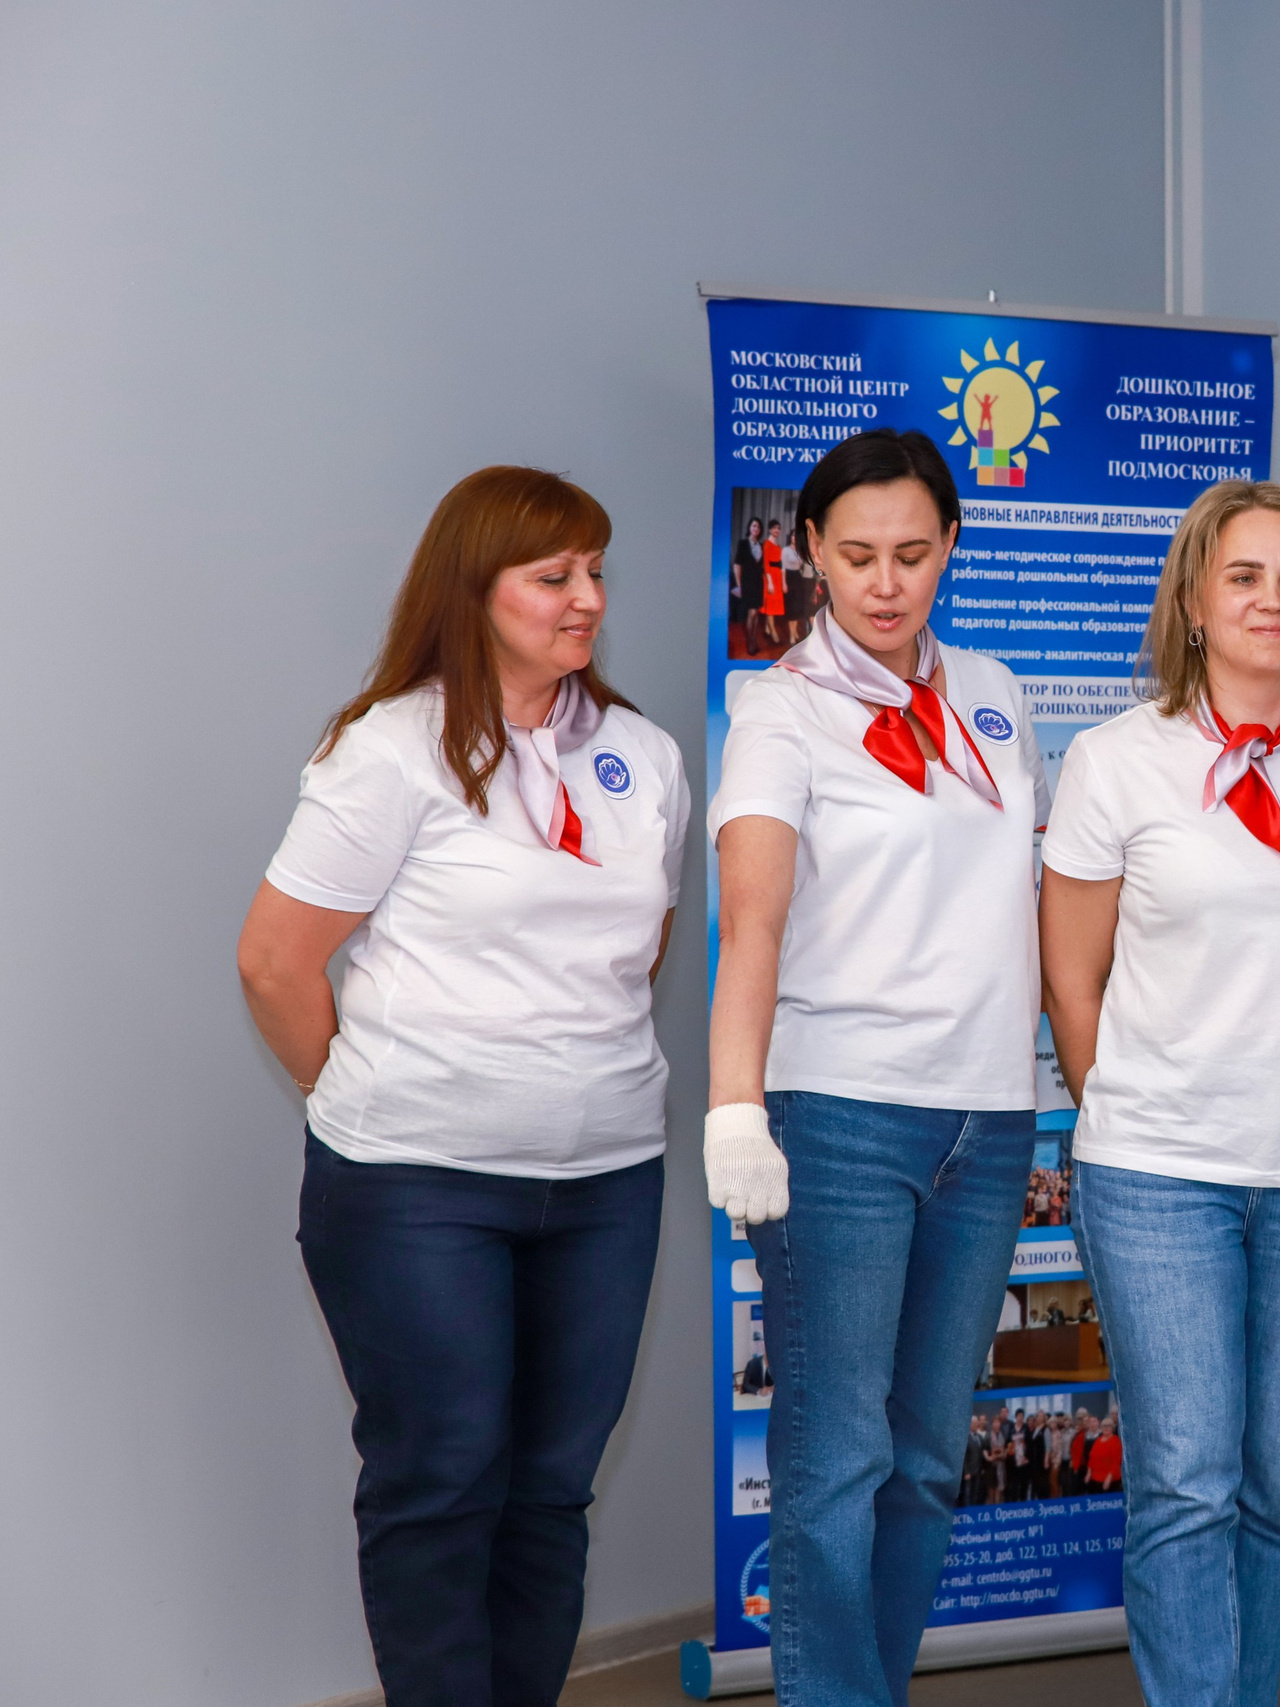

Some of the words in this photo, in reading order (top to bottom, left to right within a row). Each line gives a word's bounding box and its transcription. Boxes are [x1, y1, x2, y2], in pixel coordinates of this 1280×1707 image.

[730, 350, 862, 372] МОСКОВСКИЙ
[731, 374, 843, 394] ОБЛАСТНОЙ
[849, 380, 910, 397] ЦЕНТР
[1116, 376, 1255, 400] ДОШКОЛЬНОЕ
[732, 398, 878, 419] ДОШКОЛЬНОГО
[1106, 404, 1240, 427] ОБРАЗОВАНИЕ
[1140, 434, 1253, 455] ПРИОРИТЕТ
[1108, 460, 1252, 481] ПОДМОСКОВЬЯ
[1015, 509, 1099, 525] НАПРАВЛЕНИЯ
[1101, 512, 1182, 529] ДЕЯТЕЛЬНОСТ
[952, 546, 1071, 563] Научно-методическое
[1073, 553, 1156, 567] сопровождение
[952, 566, 1015, 581] работников
[1017, 571, 1088, 583] дошкольных
[952, 595, 1017, 609] Повышение
[1019, 598, 1120, 613] профессиональной
[952, 618, 1007, 630] педагогов
[1008, 619, 1079, 631] дошкольных
[1052, 684, 1073, 696] ПО
[1014, 1251, 1072, 1266] ОДНОГО
[1070, 1503, 1082, 1516] ул.
[950, 1530, 991, 1546] Учебный
[994, 1528, 1025, 1543] корпус
[995, 1547, 1015, 1563] доб.
[1019, 1546, 1038, 1559] 122,
[1042, 1543, 1060, 1557] 123,
[1064, 1541, 1082, 1555] 124,
[1086, 1538, 1104, 1552] 125,
[933, 1596, 957, 1610] Сайт:
